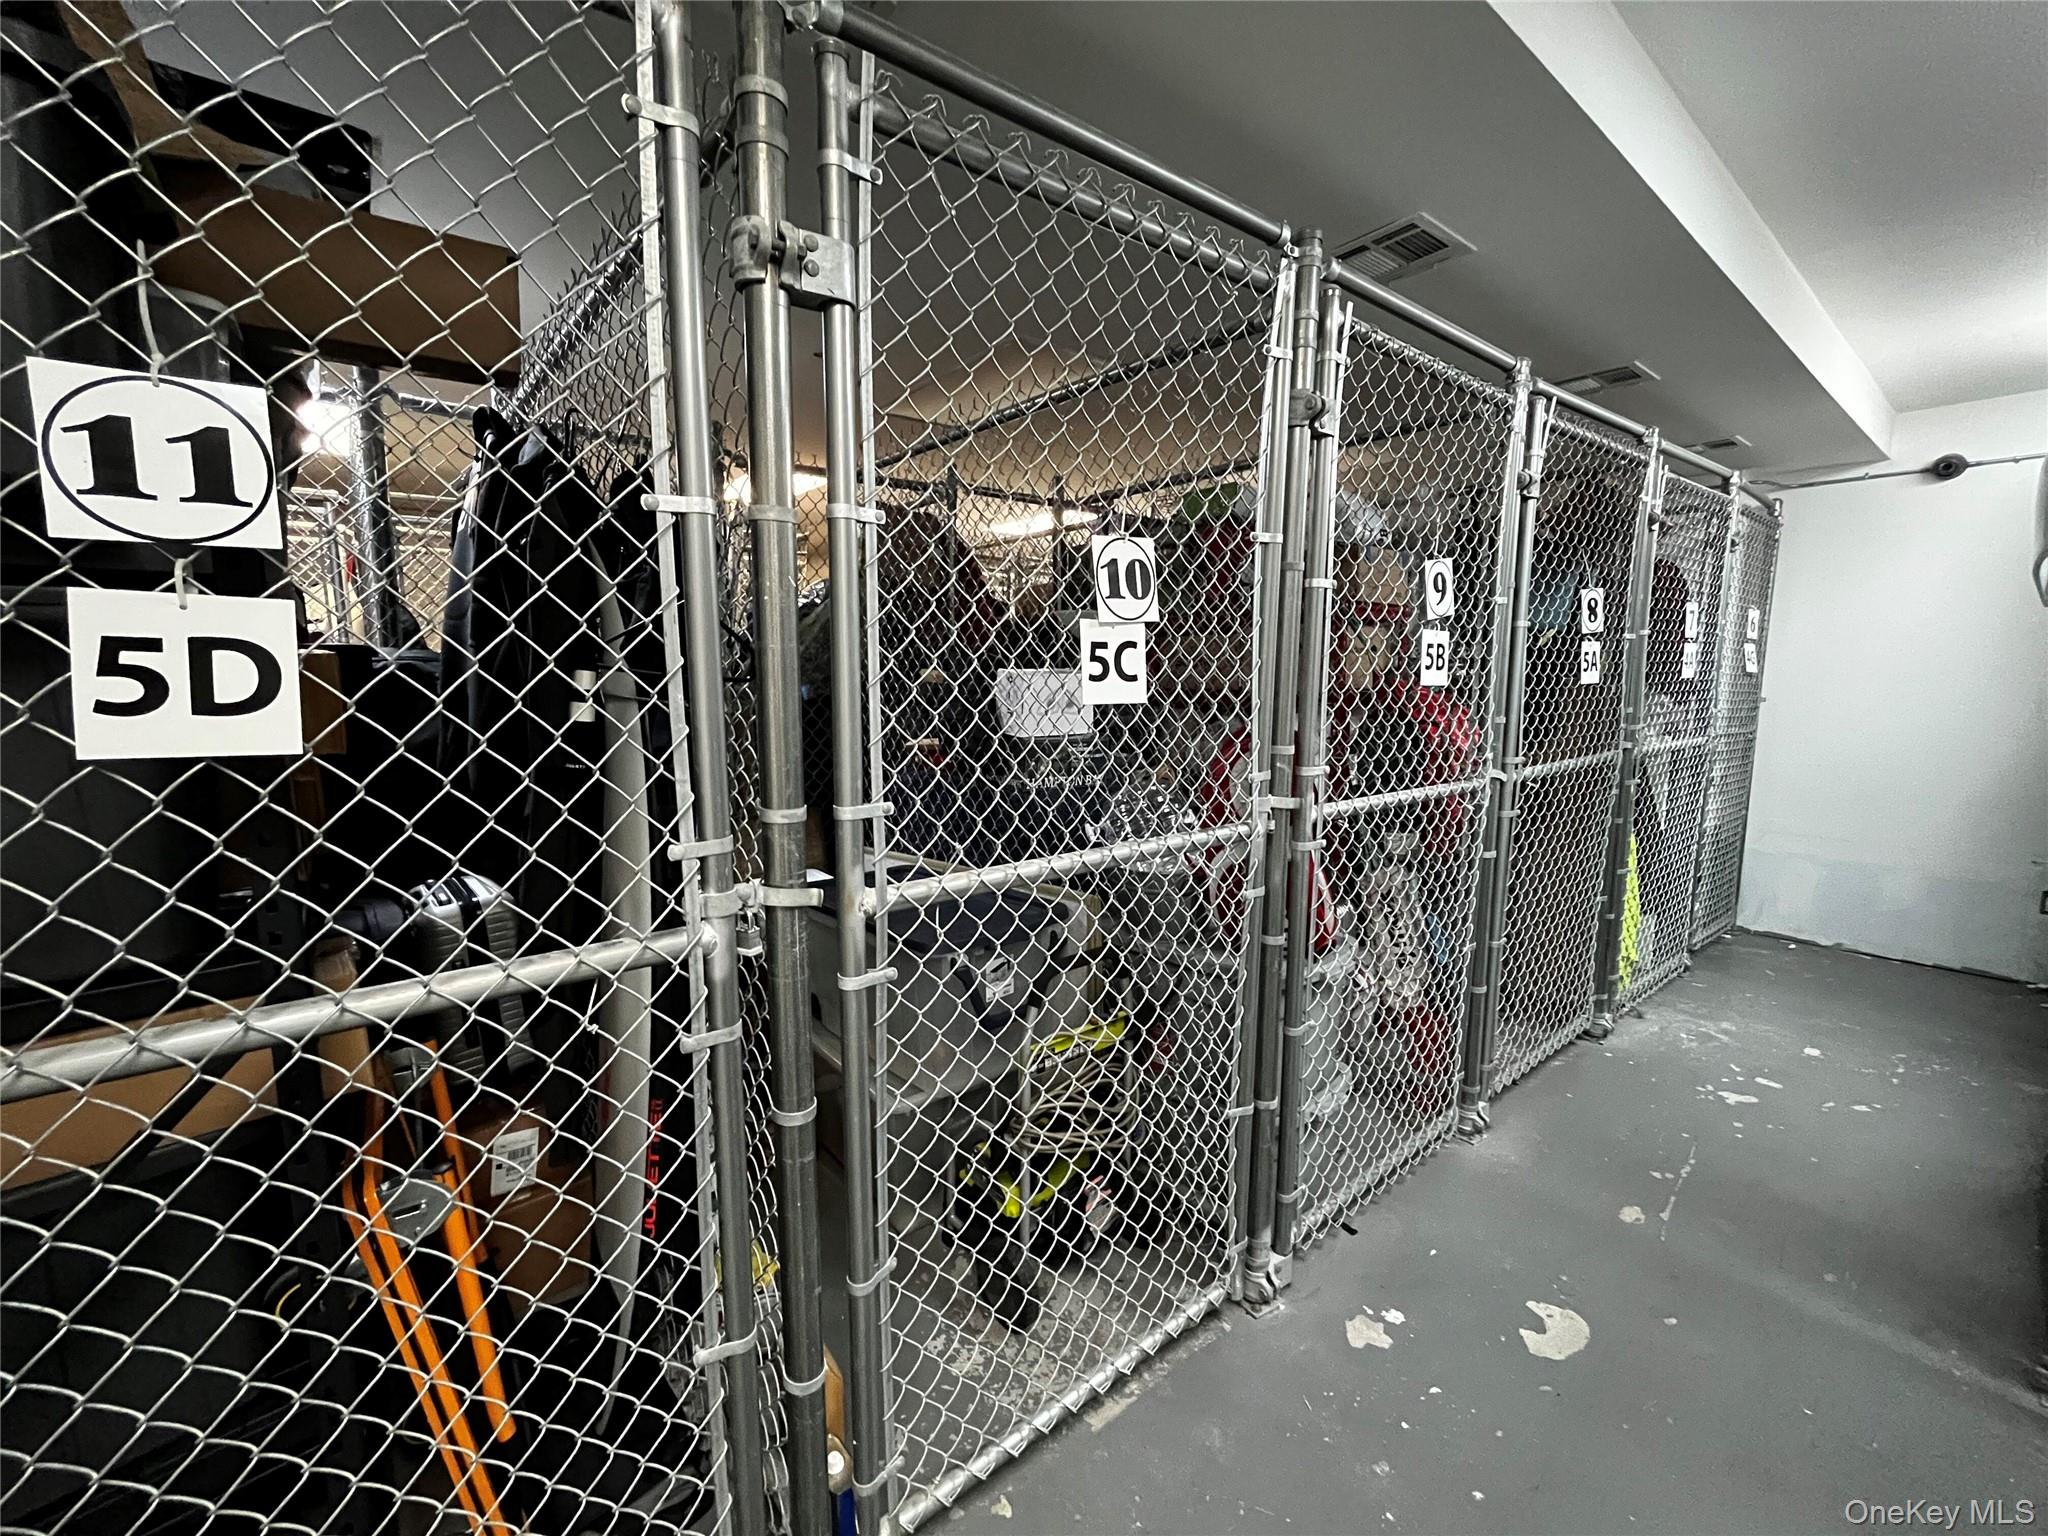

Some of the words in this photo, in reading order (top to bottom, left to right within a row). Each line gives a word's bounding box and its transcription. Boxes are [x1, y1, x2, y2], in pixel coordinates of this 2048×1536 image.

[61, 414, 254, 508] 11
[1101, 558, 1152, 600] 10
[1432, 571, 1447, 606] 9
[1587, 597, 1599, 624] 8
[92, 635, 282, 717] 5D
[1088, 640, 1139, 683] 5C
[1424, 643, 1446, 671] 5B
[1582, 650, 1599, 673] 5A
